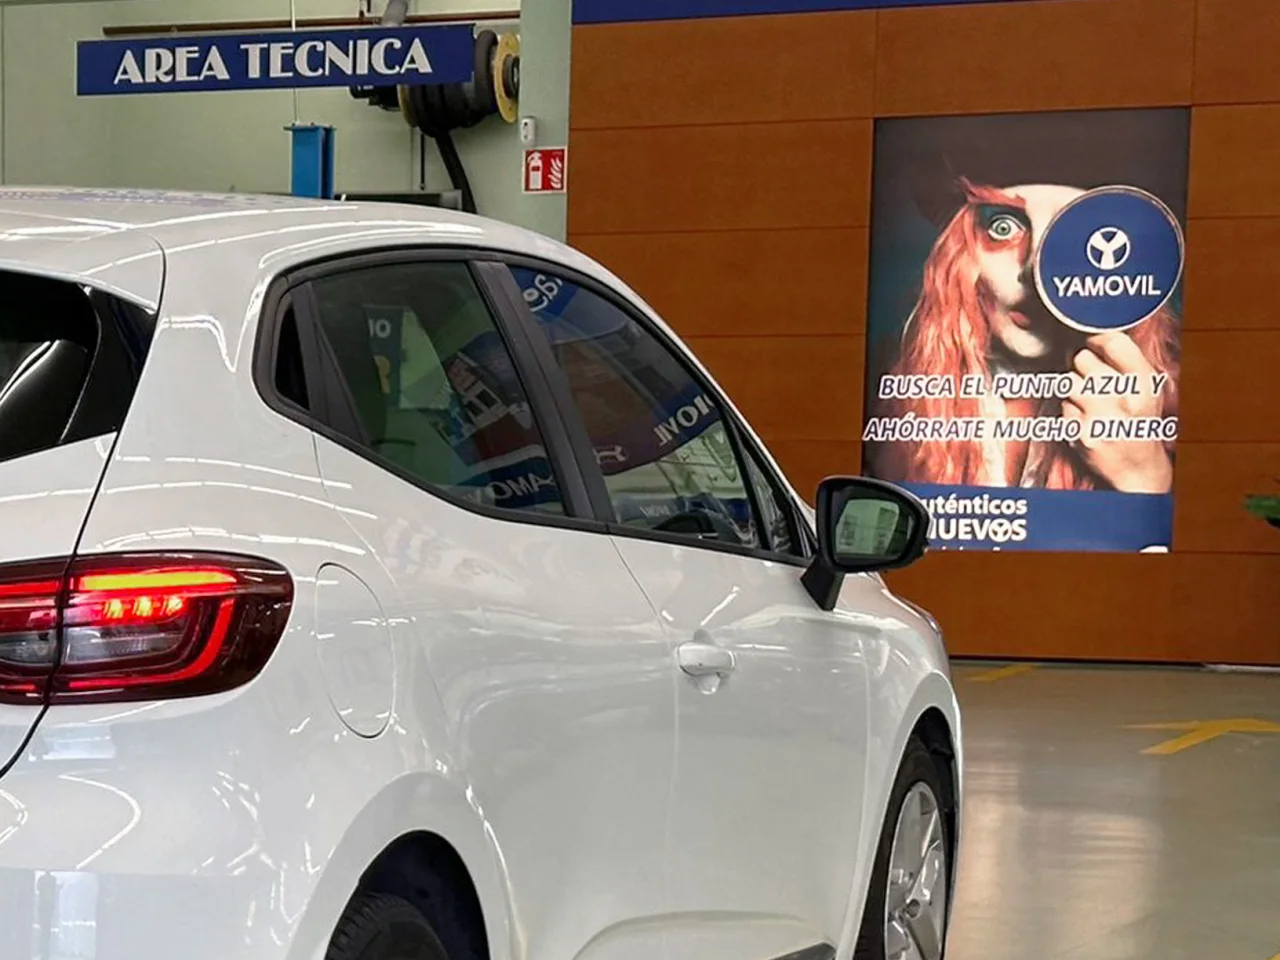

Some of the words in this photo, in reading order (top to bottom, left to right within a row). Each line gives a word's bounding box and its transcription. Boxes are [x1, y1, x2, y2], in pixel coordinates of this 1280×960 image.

[114, 45, 231, 85] AREA
[240, 38, 433, 79] TECNICA
[1053, 275, 1161, 297] YAMOVIL
[879, 375, 954, 398] BUSCA
[962, 375, 986, 397] EL
[994, 374, 1074, 398] PUNTO
[1080, 374, 1141, 396] AZUL
[1150, 374, 1169, 396] Y
[863, 412, 985, 441] AHÓRRATE
[993, 417, 1081, 441] MUCHO
[1090, 417, 1179, 441] DINERO
